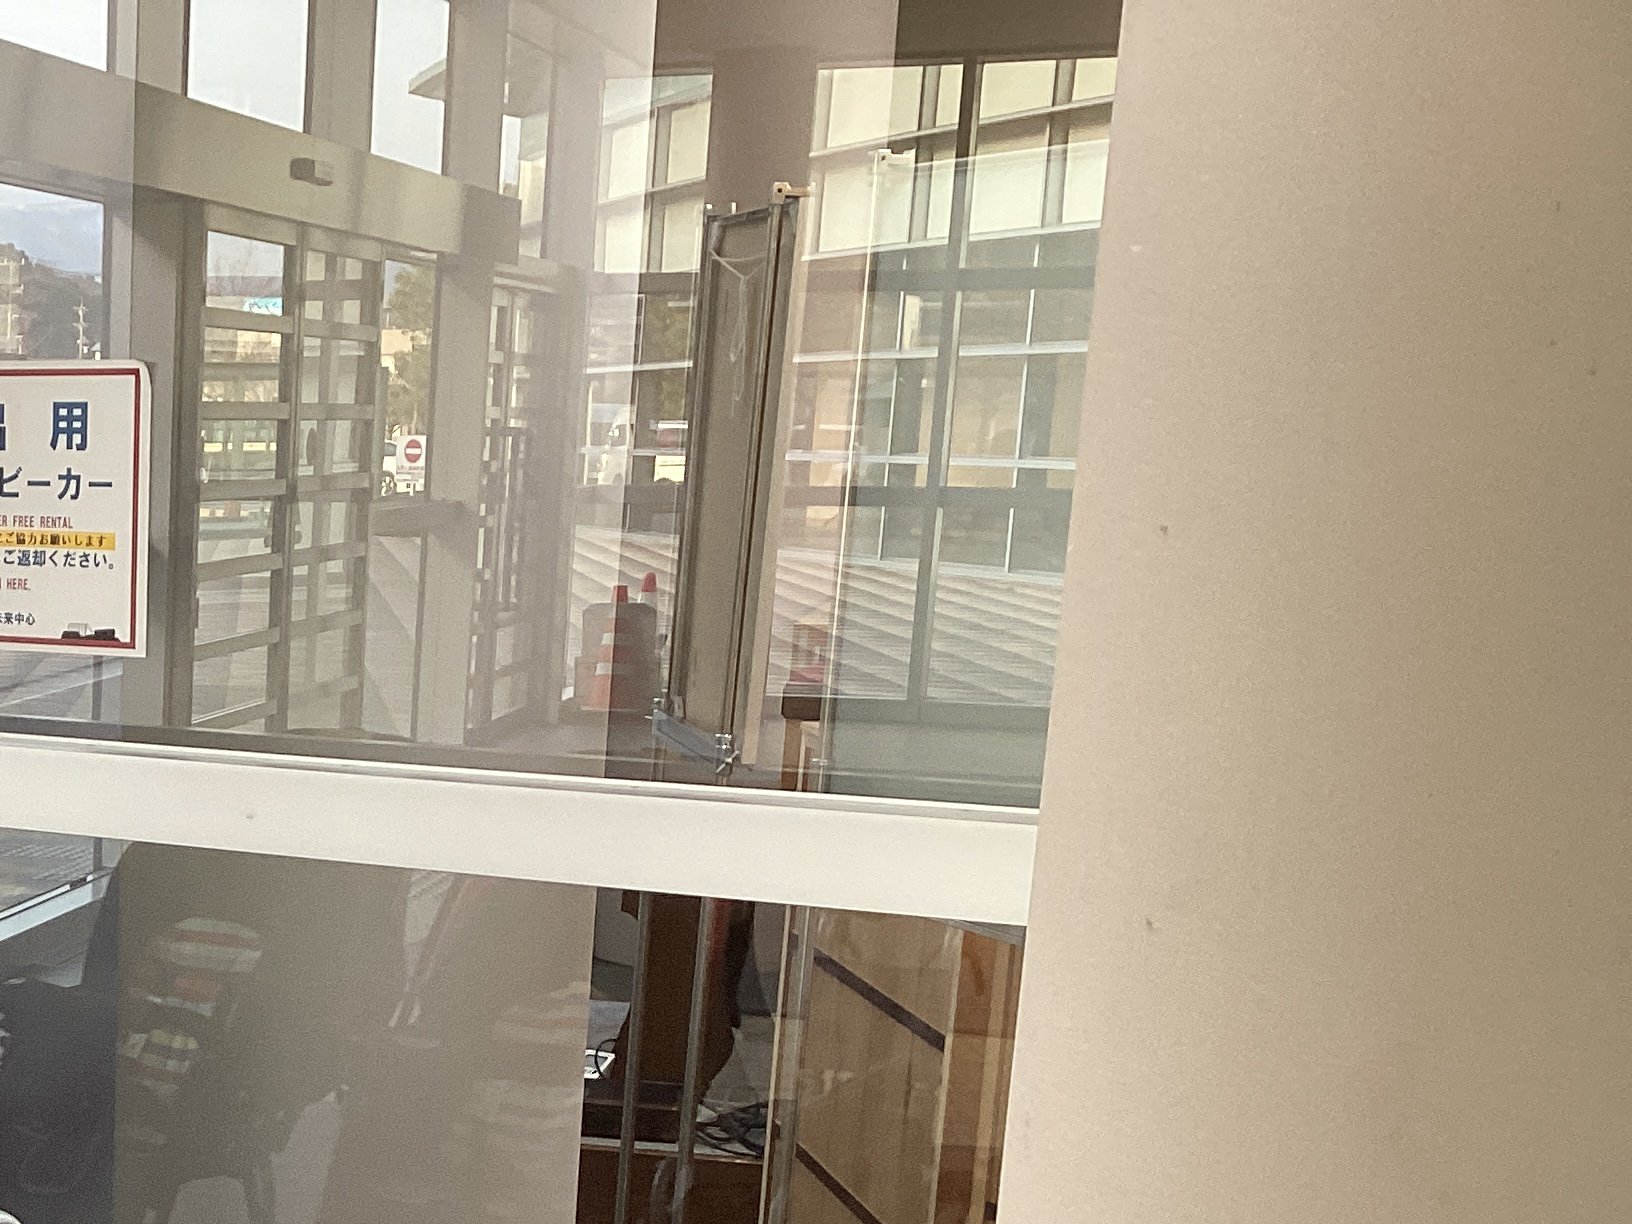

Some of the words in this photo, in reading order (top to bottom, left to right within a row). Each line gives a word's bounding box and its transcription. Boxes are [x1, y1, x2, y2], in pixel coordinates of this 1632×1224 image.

[12, 515, 35, 528] FREE
[39, 516, 73, 529] RENTAL
[6, 578, 32, 591] HERE.
